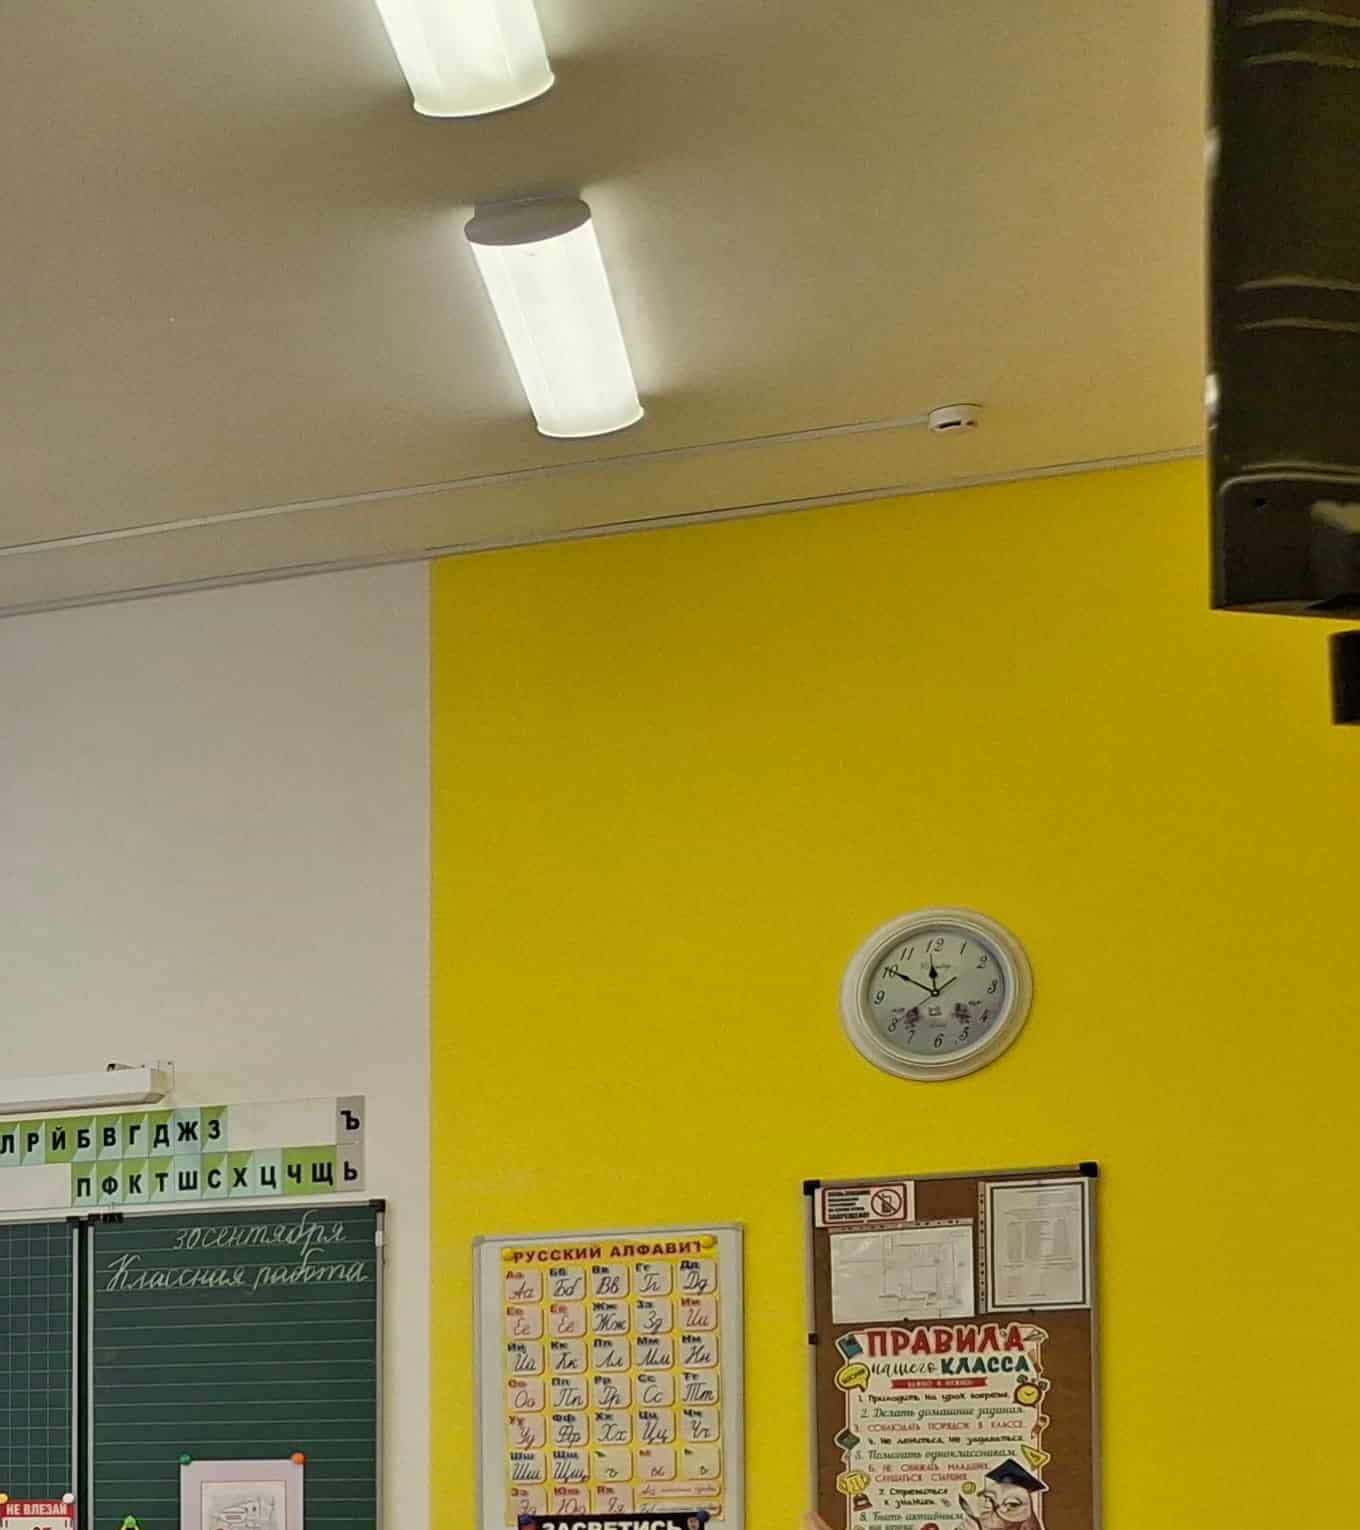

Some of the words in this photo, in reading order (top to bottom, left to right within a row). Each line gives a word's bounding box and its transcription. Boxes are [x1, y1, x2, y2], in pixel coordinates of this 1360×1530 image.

[926, 937, 944, 952] 12
[900, 947, 914, 961] 11
[874, 990, 885, 1005] 9
[934, 1033, 944, 1048] 6
[513, 1247, 602, 1264] РУССКИЙ
[610, 1241, 701, 1258] АЛФАВИТ
[252, 1248, 369, 1294] работа
[867, 1325, 1025, 1358] ПРАВИЛА
[871, 1361, 938, 1379] нашего
[941, 1355, 1031, 1375] КЛАССА
[6, 1503, 21, 1515] НЕ
